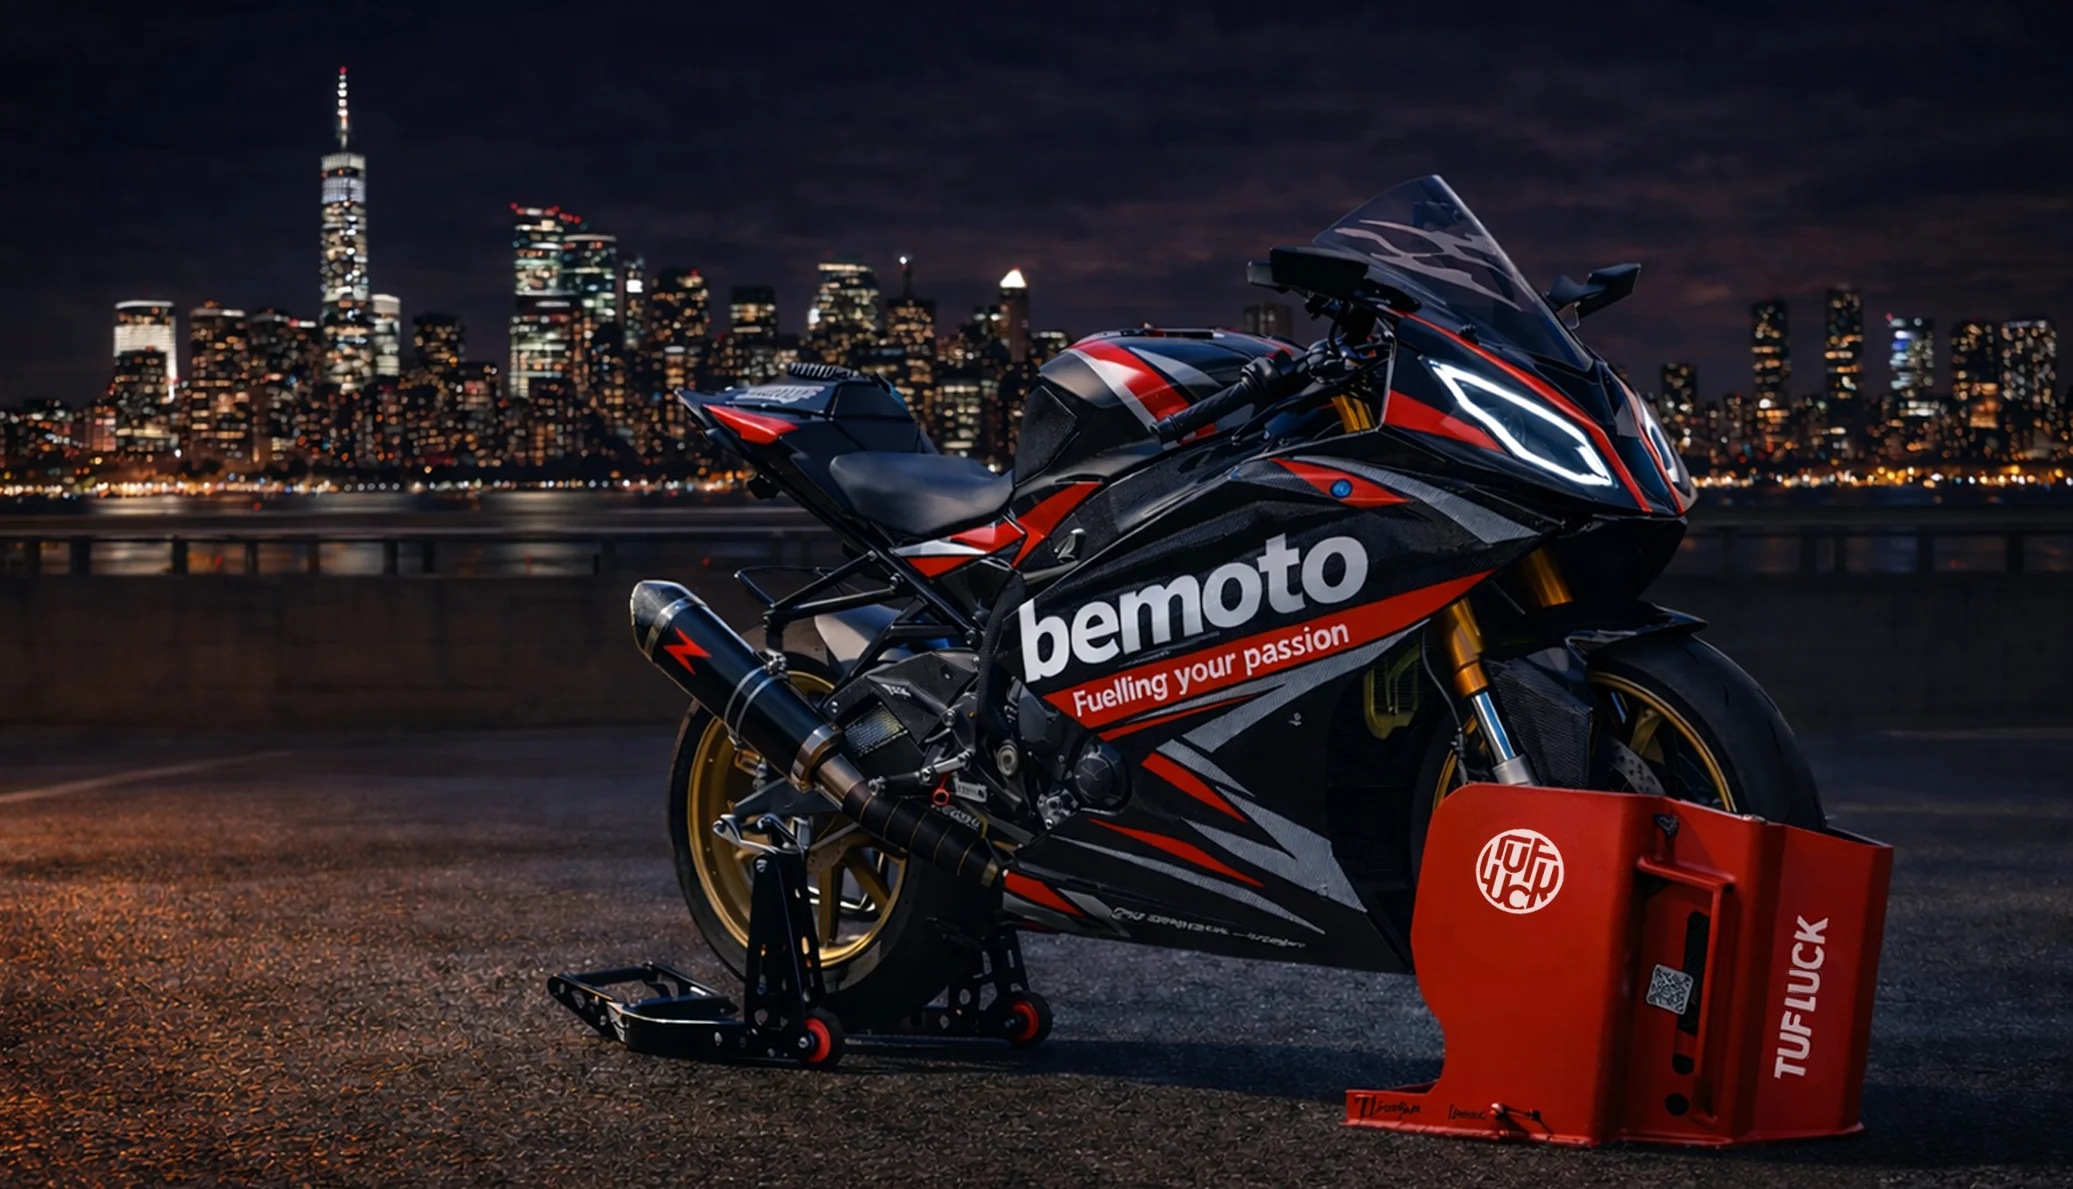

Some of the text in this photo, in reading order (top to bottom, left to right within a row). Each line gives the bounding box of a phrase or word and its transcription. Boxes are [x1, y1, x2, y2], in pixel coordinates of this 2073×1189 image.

[1018, 533, 1369, 683] bemoto
[1072, 623, 1350, 718] Fuelling your passion
[1773, 915, 1829, 1080] TUFLUCK
